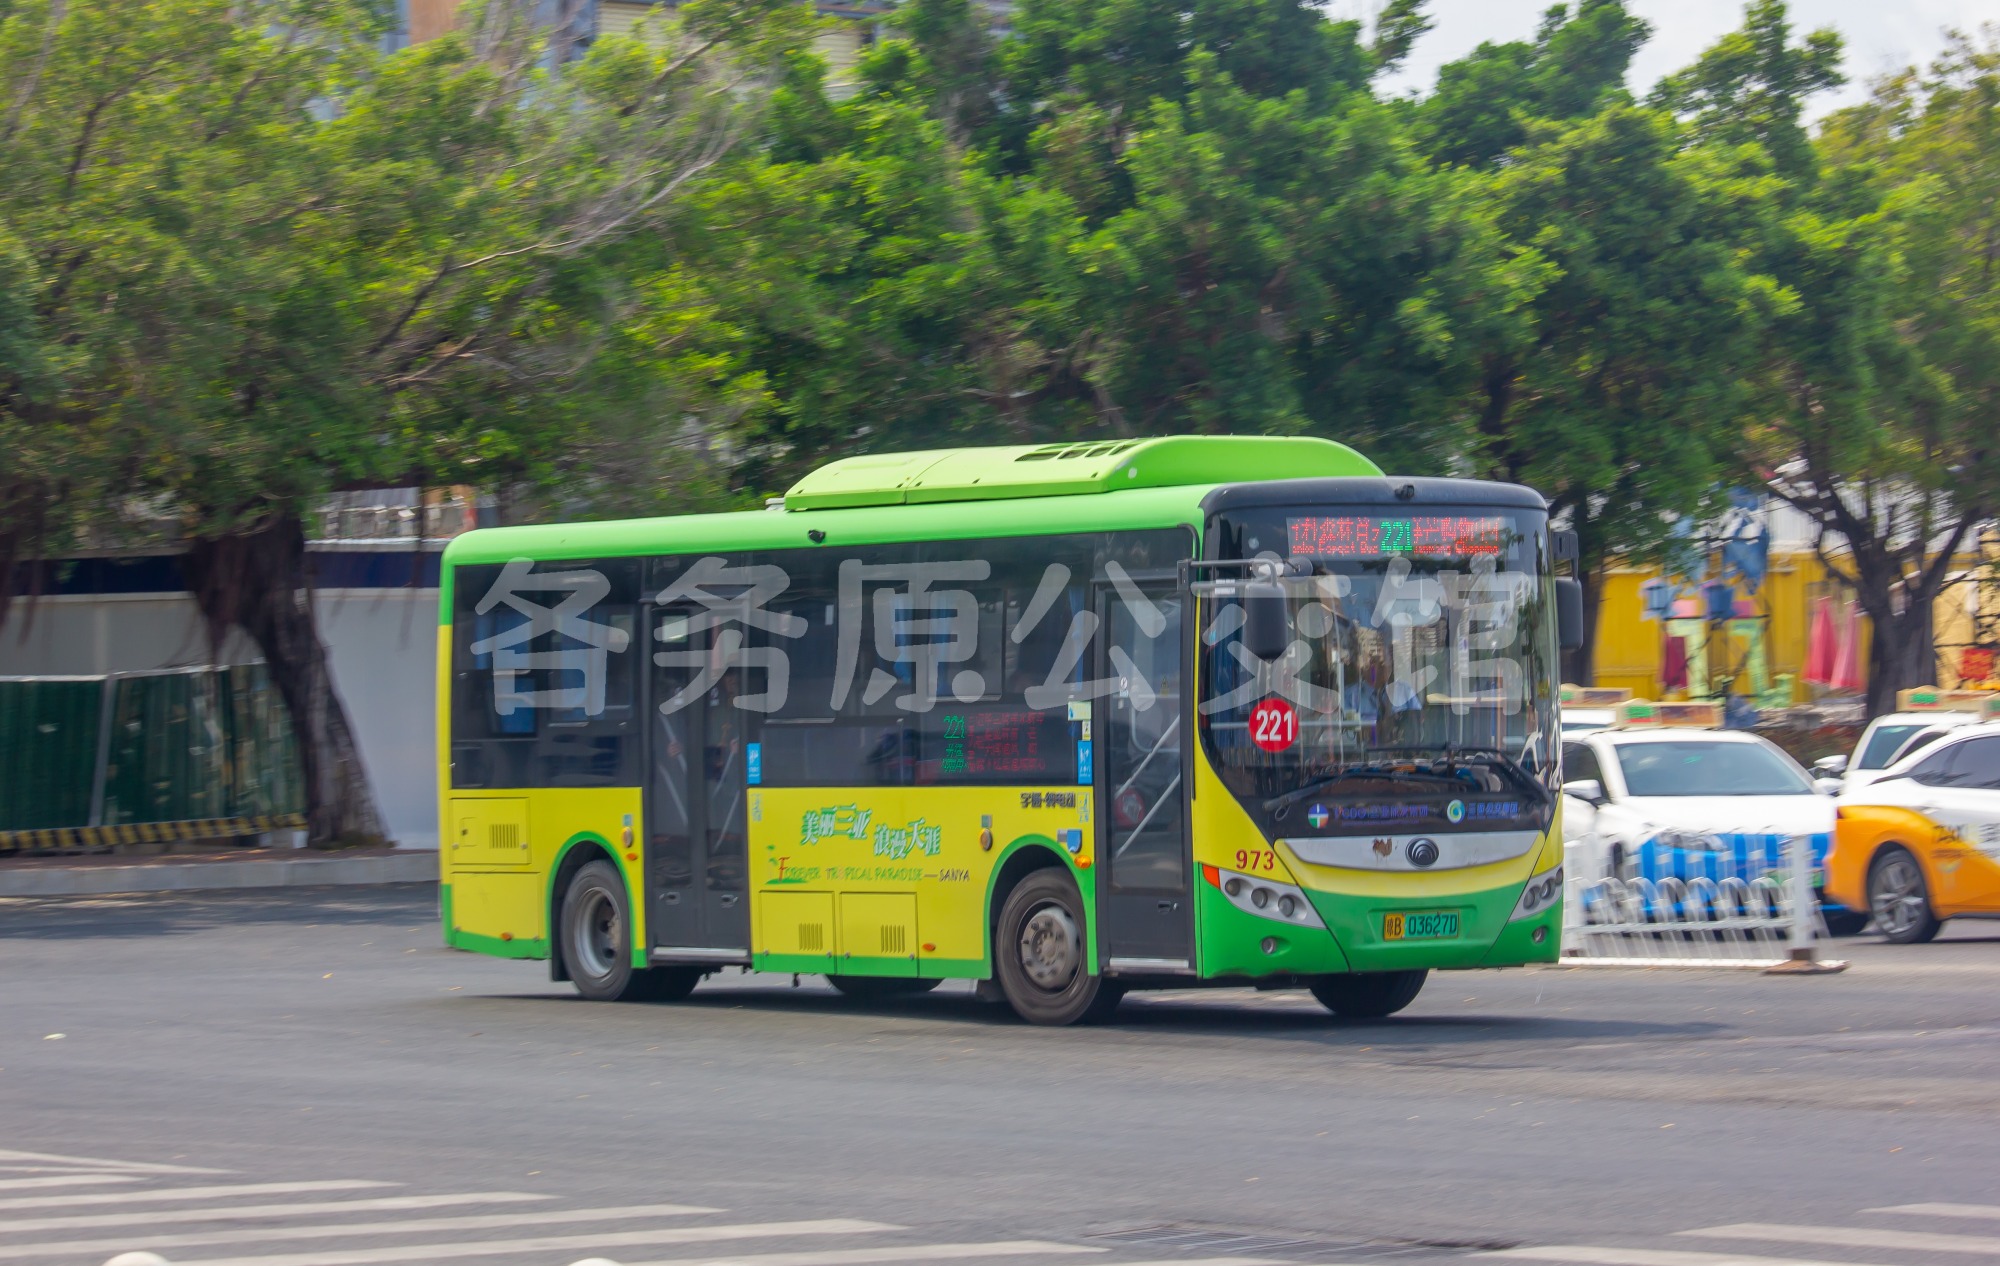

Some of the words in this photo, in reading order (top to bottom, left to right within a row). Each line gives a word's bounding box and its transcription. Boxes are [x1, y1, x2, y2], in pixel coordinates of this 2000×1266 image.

[1380, 521, 1412, 551] 221
[943, 715, 965, 739] 221
[1255, 709, 1293, 742] 221
[800, 803, 873, 845] 美丽三亚
[873, 817, 942, 861] 浪漫天涯
[1235, 849, 1275, 871] 973
[938, 868, 970, 882] SANYA
[1408, 914, 1457, 936] 03627D
